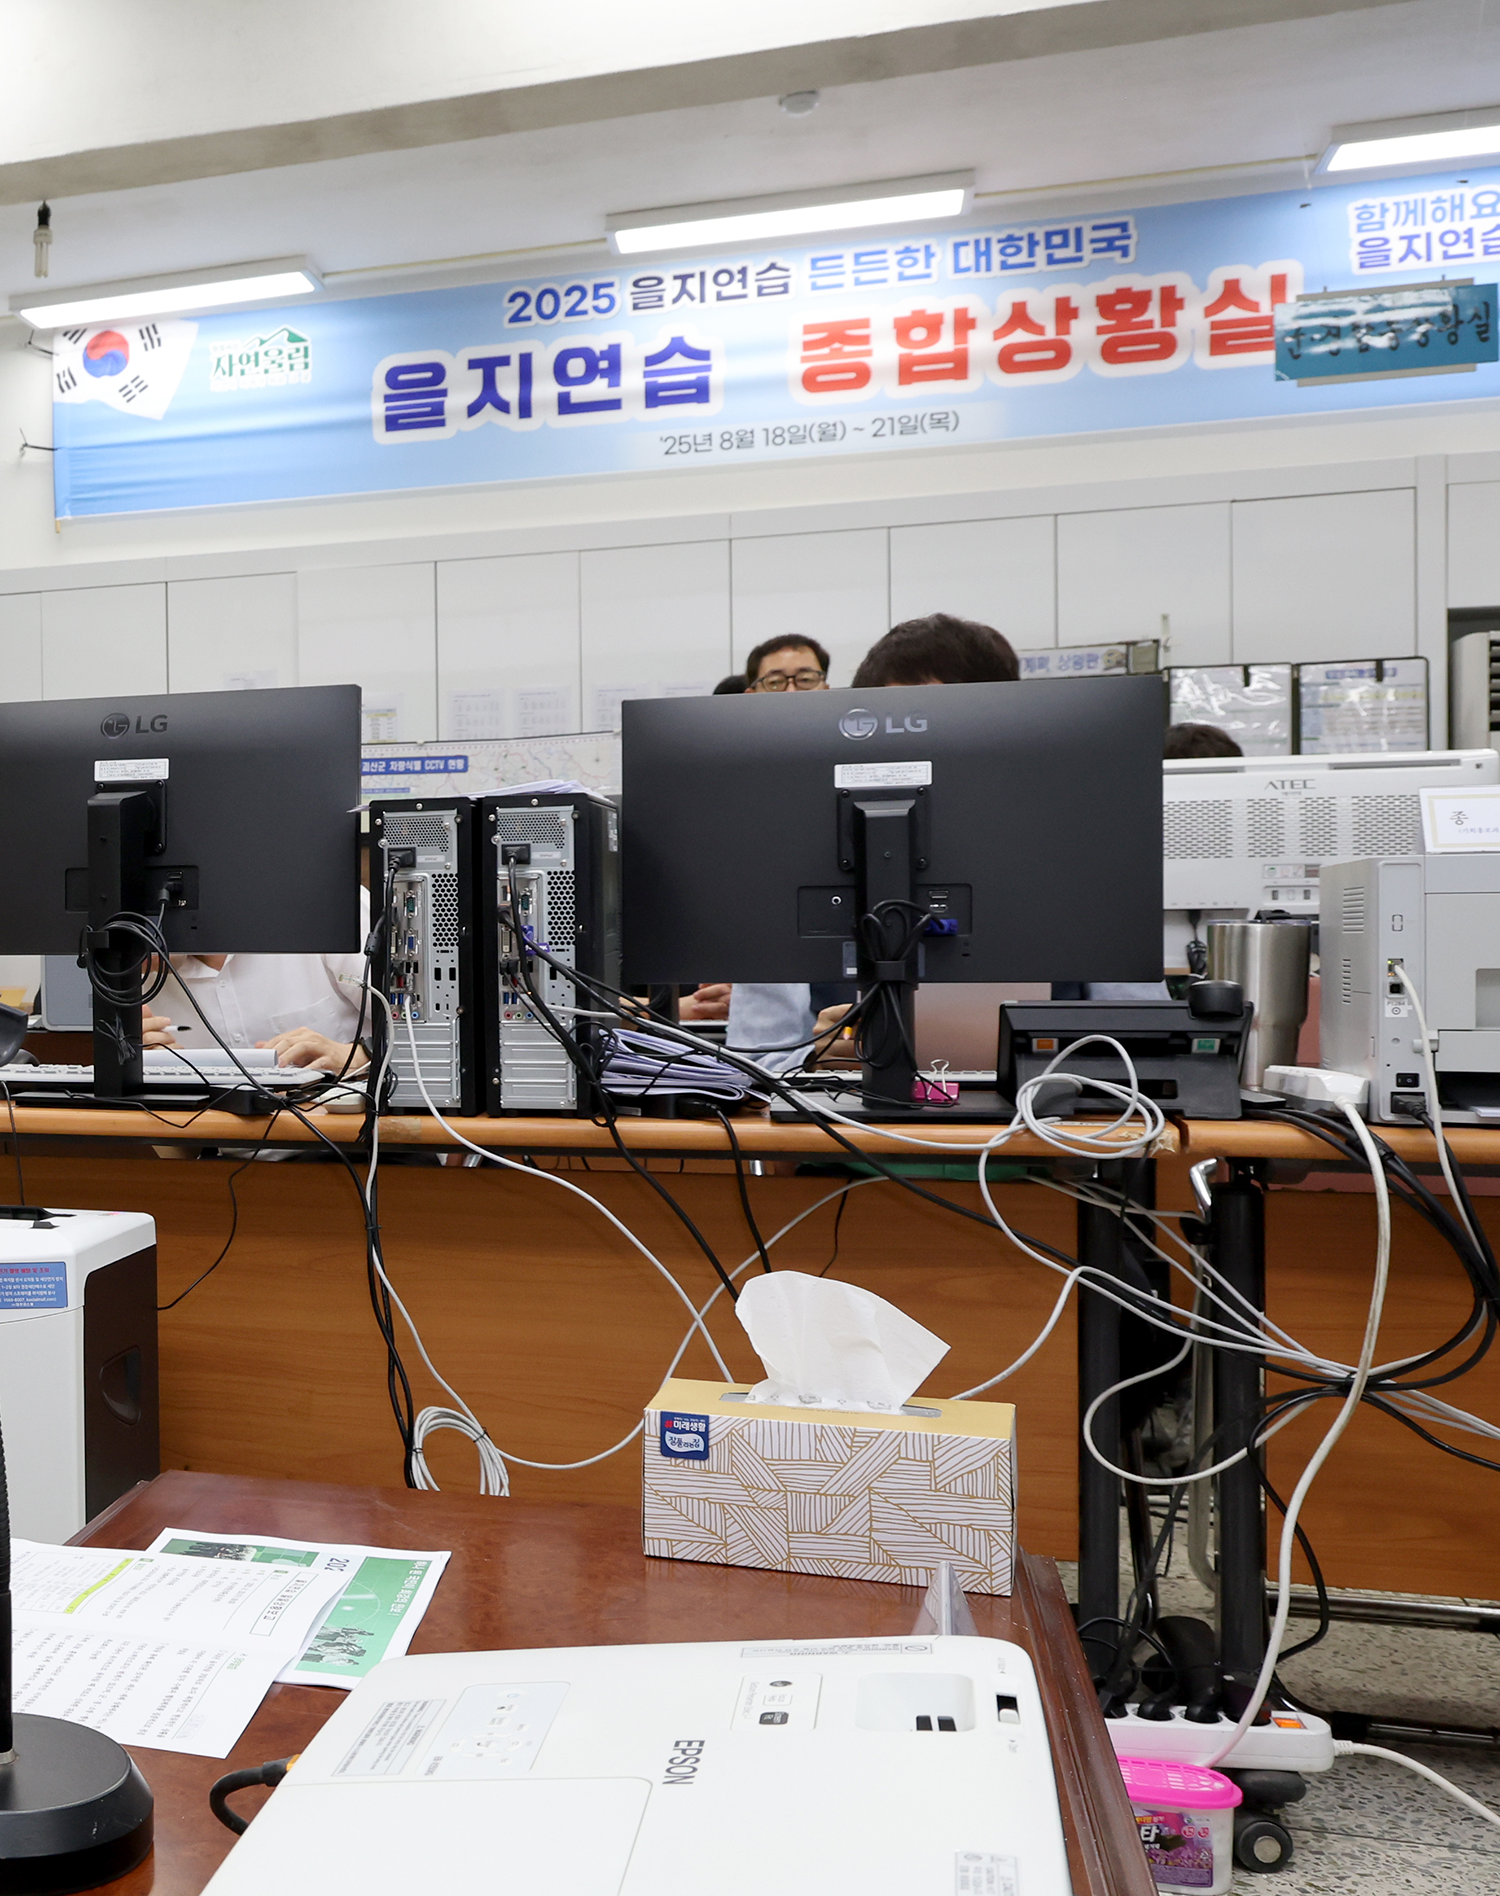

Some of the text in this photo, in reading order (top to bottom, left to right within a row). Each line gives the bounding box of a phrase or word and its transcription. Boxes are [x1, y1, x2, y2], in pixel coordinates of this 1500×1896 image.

[1354, 189, 1500, 233] 함께해요
[507, 220, 1133, 324] 2025 을지연습 든든한 대한민국
[384, 274, 1287, 432] 을지연습 종합상황실
[660, 432, 713, 455] '25년
[719, 429, 755, 450] 8월
[762, 420, 847, 447] 18일(월)
[871, 410, 960, 438] 21일(목)
[135, 714, 168, 734] LG
[885, 713, 928, 733] LG
[424, 759, 445, 771] CCTV
[1264, 778, 1316, 790] ATEC
[673, 1420, 706, 1432] 미래생활
[662, 1740, 706, 1785] EPSON
